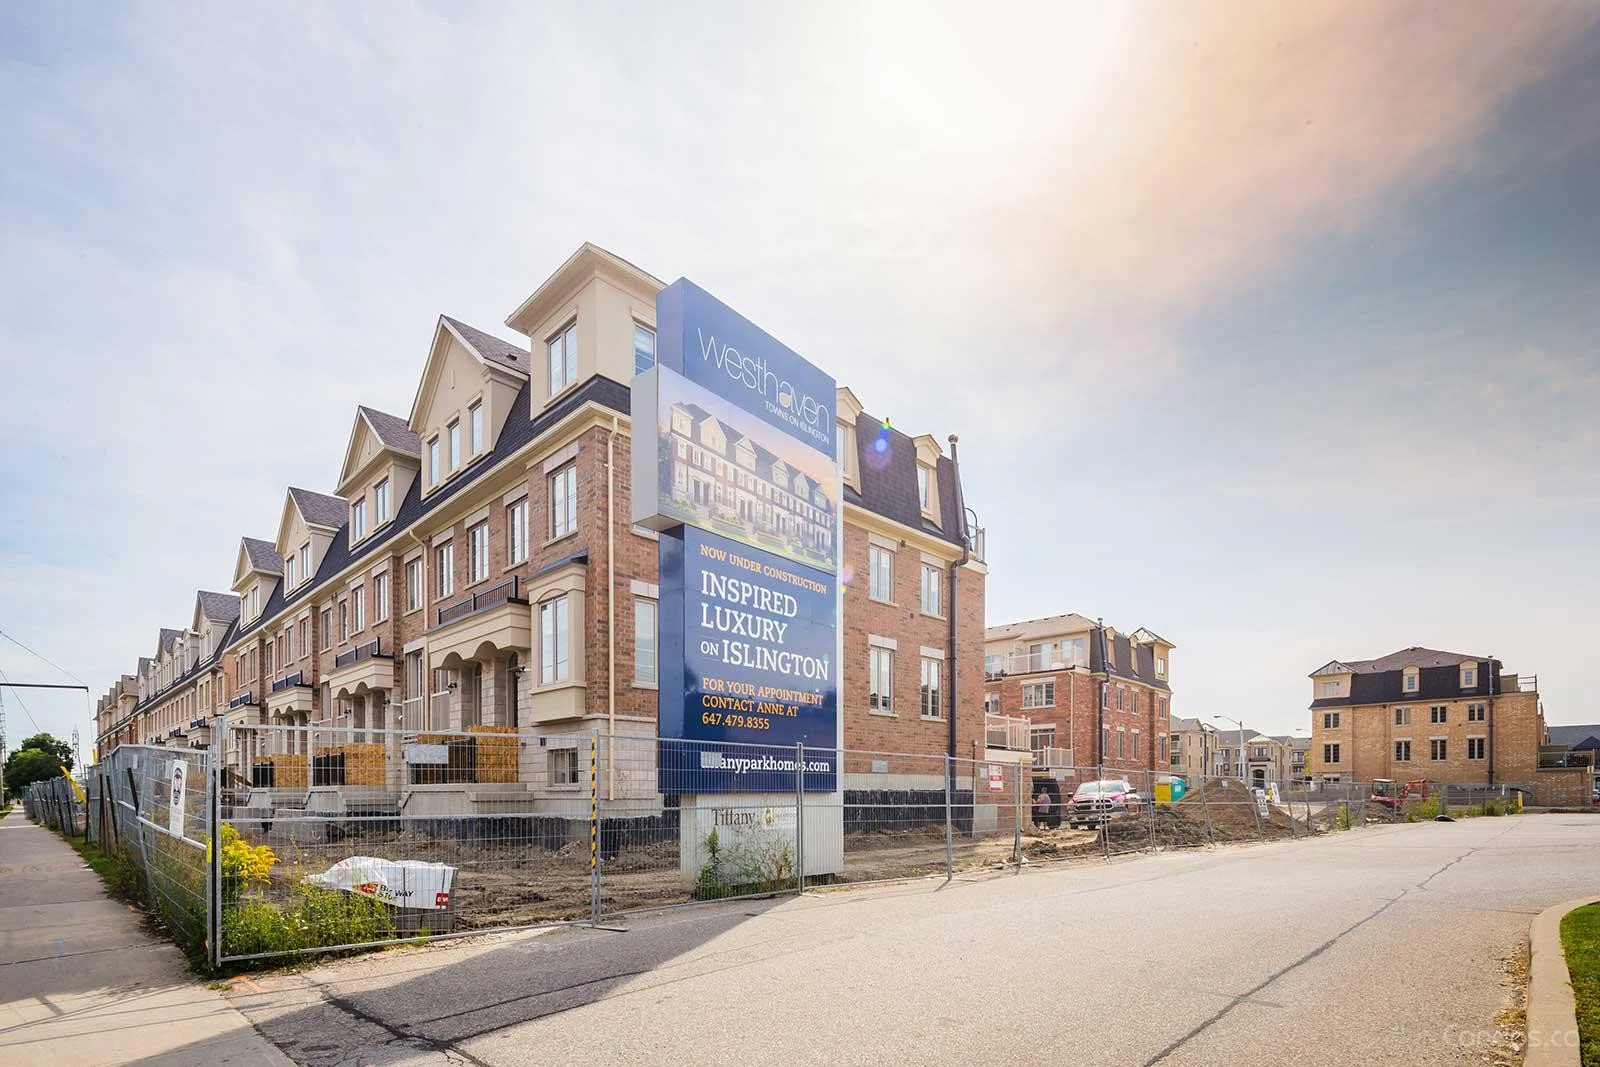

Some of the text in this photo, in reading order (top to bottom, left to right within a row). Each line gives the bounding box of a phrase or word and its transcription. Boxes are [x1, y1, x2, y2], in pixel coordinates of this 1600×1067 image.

[697, 327, 830, 434] Westhaven
[764, 400, 830, 445] TOWNS ON ISLINGTON
[700, 543, 827, 595] NOW UNDER CONSTRUCTION
[701, 570, 798, 618] INSPIRED
[701, 602, 788, 644] LUXURY
[700, 639, 829, 681] ON ISLINGTON
[702, 677, 824, 706] FOR YOUR APPOINTMENT
[702, 695, 799, 717] CONTACT ANNE AT
[702, 712, 770, 730] 647.479.8355
[701, 753, 830, 774] anyparkhomes.com
